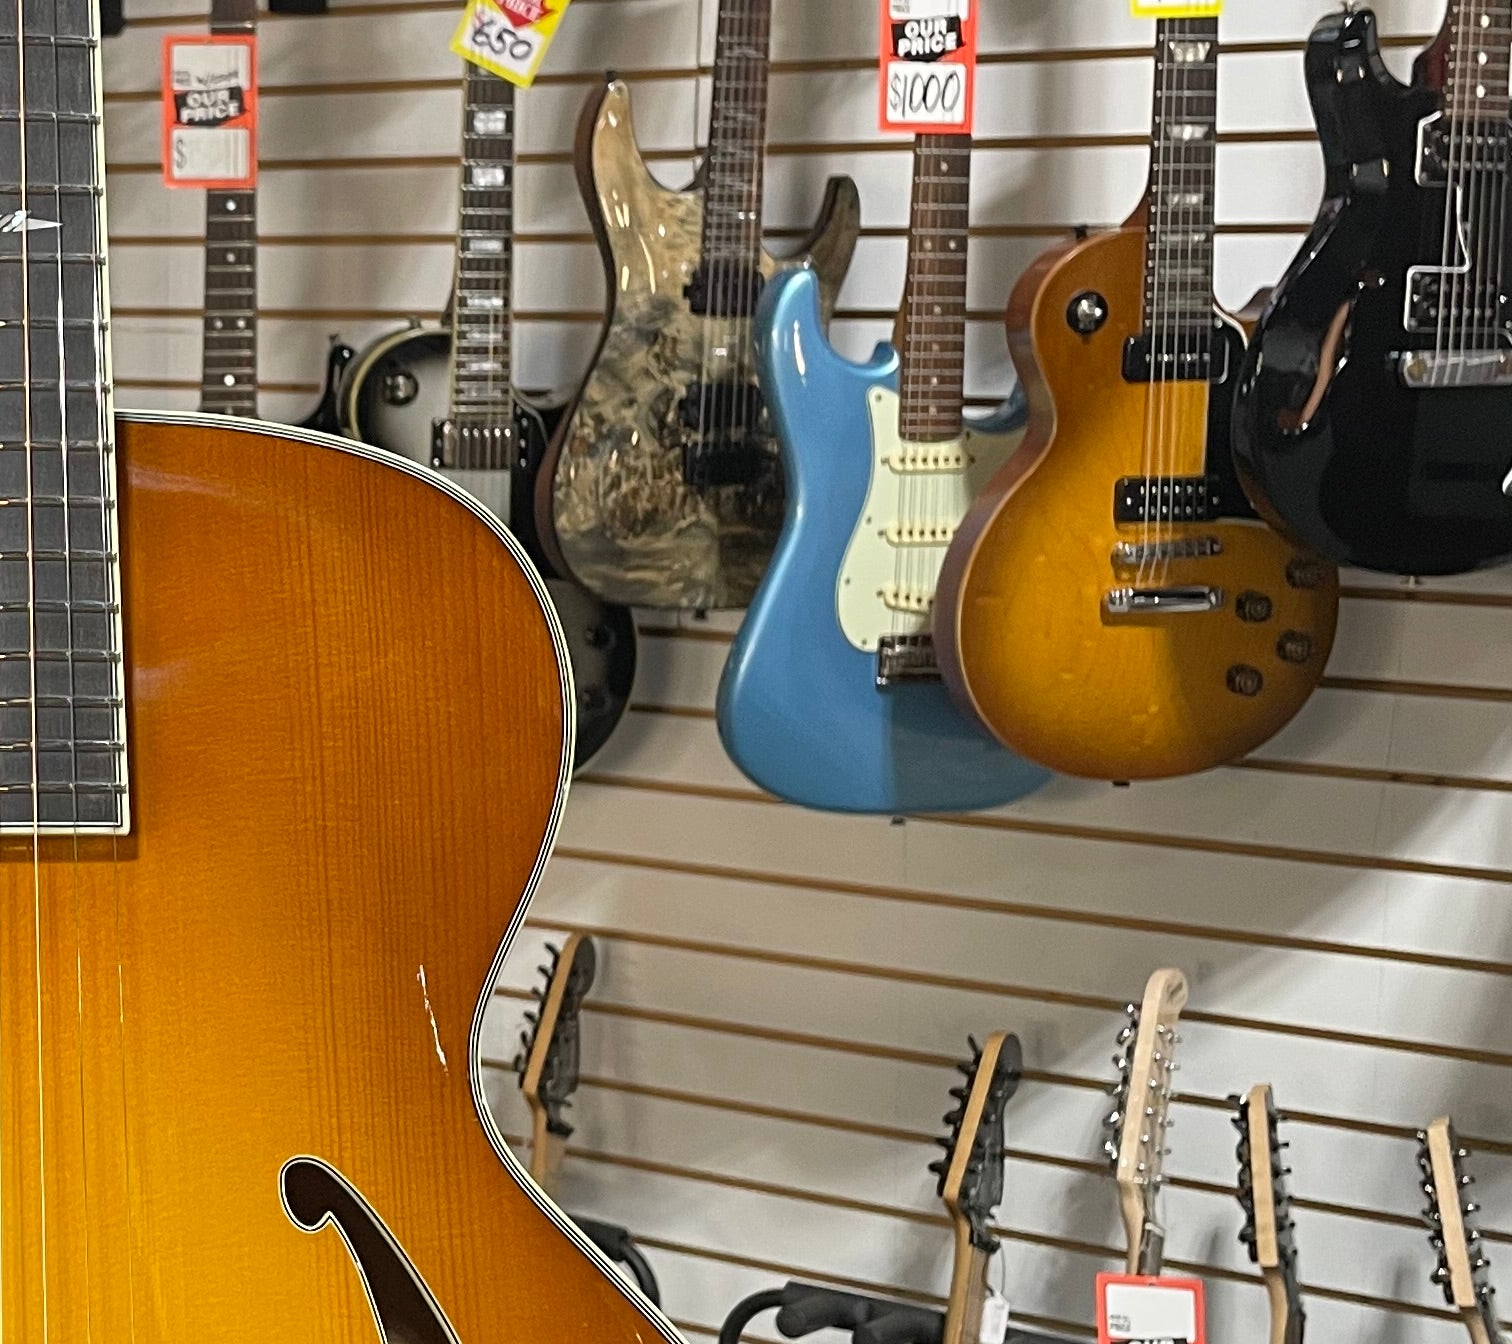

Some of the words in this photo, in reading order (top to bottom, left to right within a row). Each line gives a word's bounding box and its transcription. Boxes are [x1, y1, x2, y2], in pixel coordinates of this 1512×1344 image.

[472, 5, 533, 60] $650
[904, 18, 947, 40] OUR
[897, 31, 957, 57] PRICE
[186, 90, 230, 108] OUR
[890, 70, 961, 119] $1000
[180, 102, 240, 124] PRICE
[175, 139, 186, 170] $
